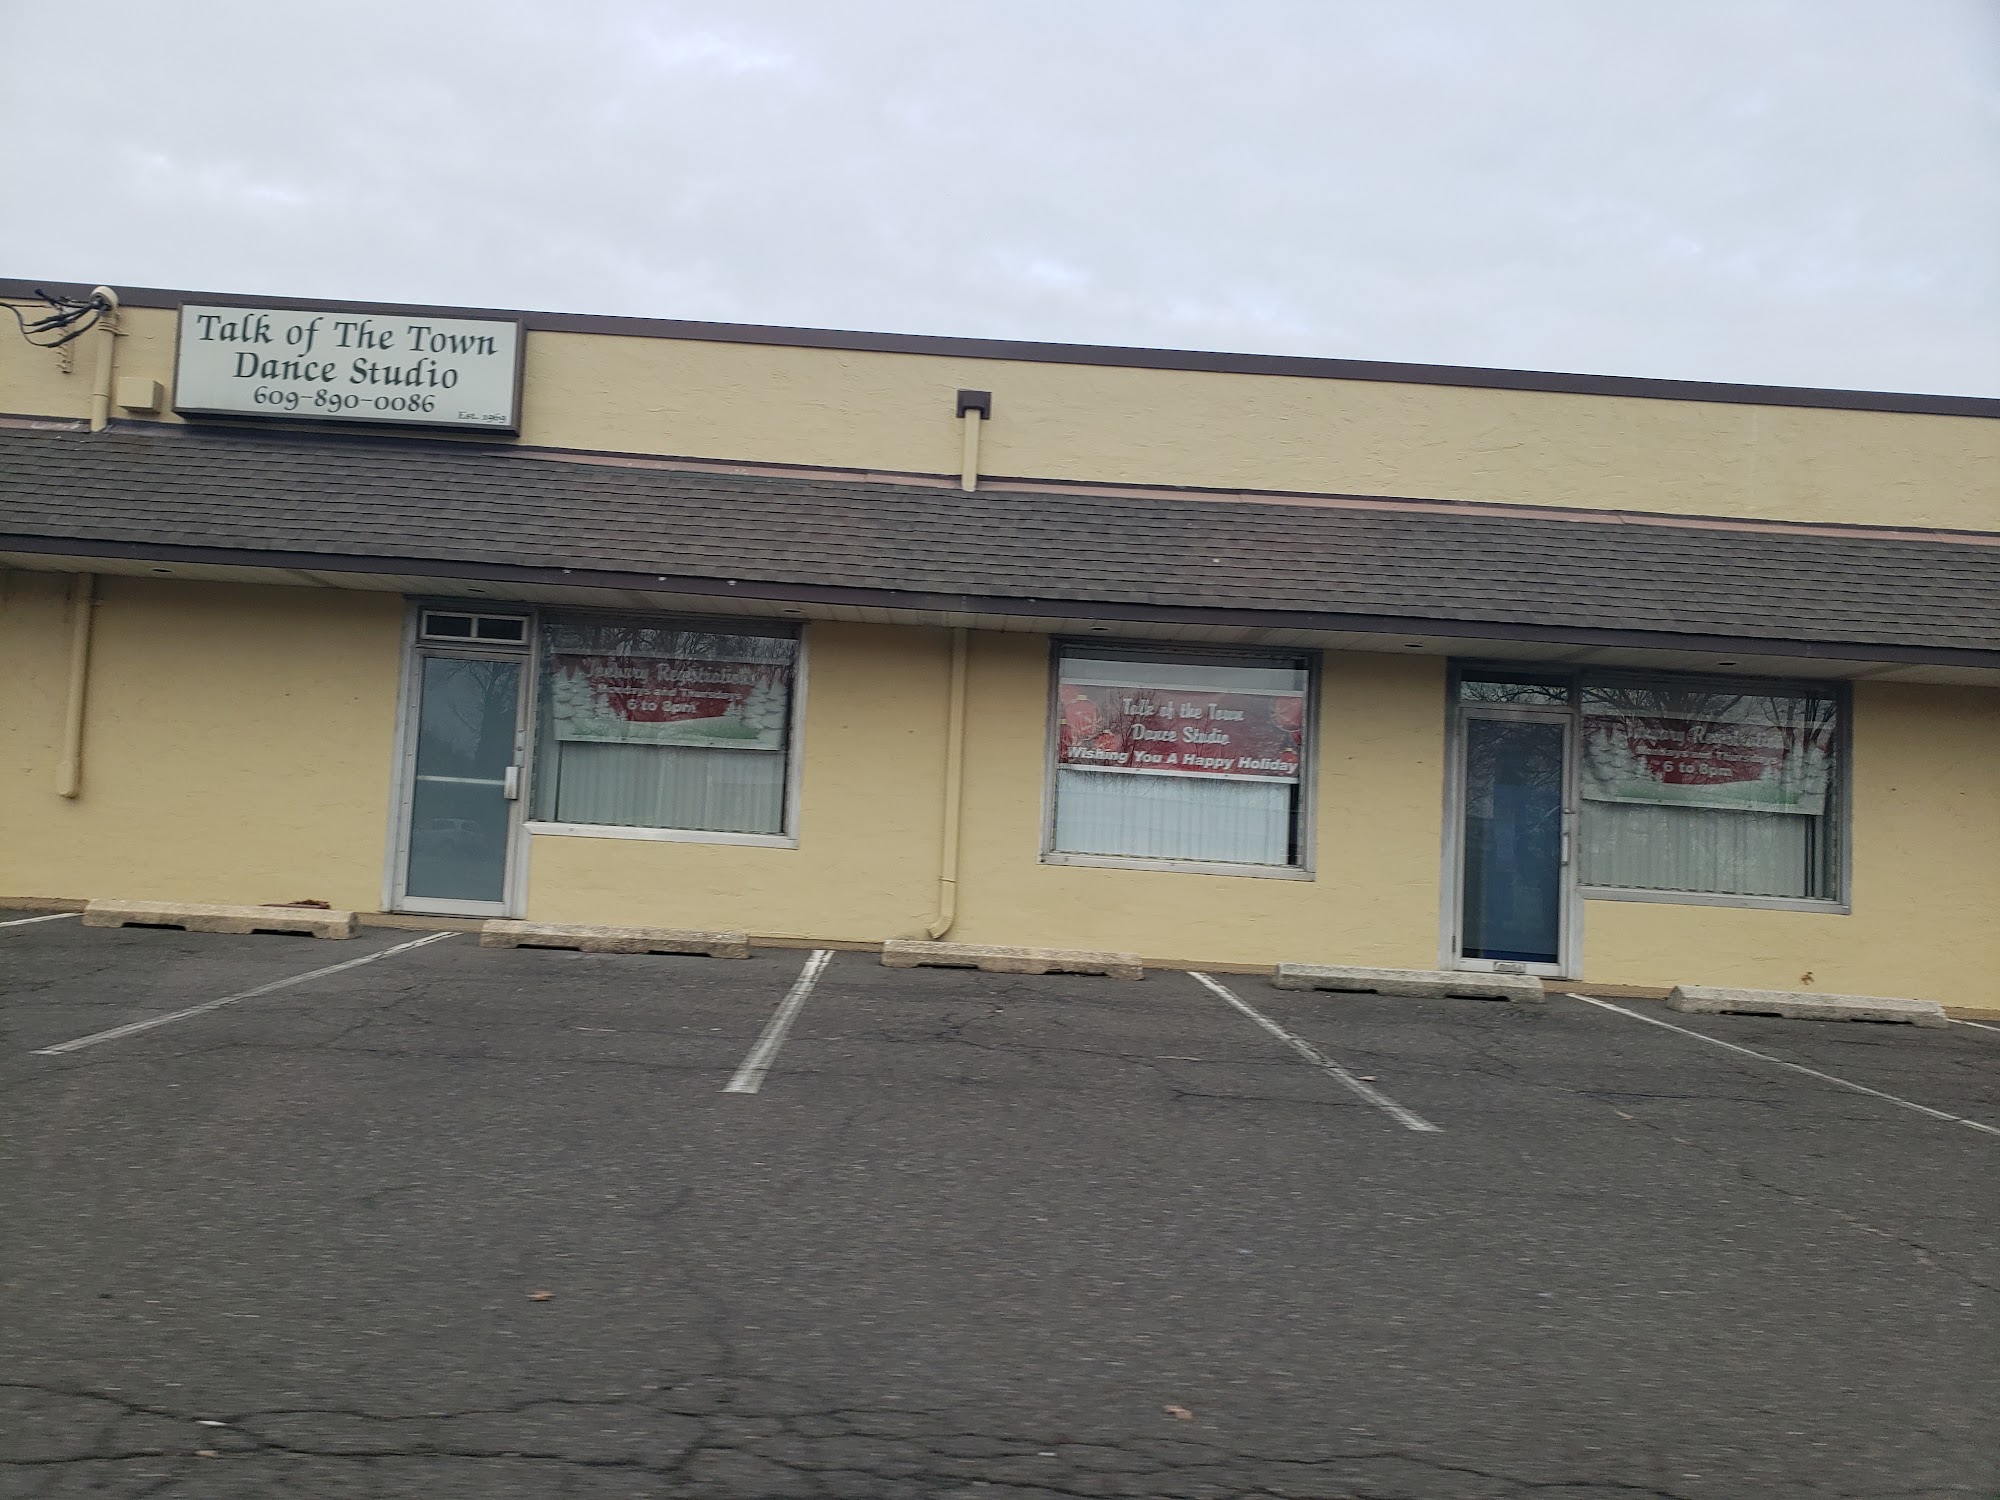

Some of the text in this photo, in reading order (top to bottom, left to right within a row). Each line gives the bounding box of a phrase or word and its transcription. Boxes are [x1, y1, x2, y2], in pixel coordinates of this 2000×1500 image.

[197, 313, 499, 357] Talk of The Town
[232, 351, 459, 389] Dance Studio
[254, 385, 436, 413] 609-890-0086
[641, 700, 657, 711] to
[1122, 698, 1245, 721] Talk of the Town
[1131, 723, 1231, 746] Dance Studio
[1068, 746, 1299, 774] Wishing You A Happy Holiday
[1662, 760, 1673, 773] 6
[1679, 761, 1695, 774] to
